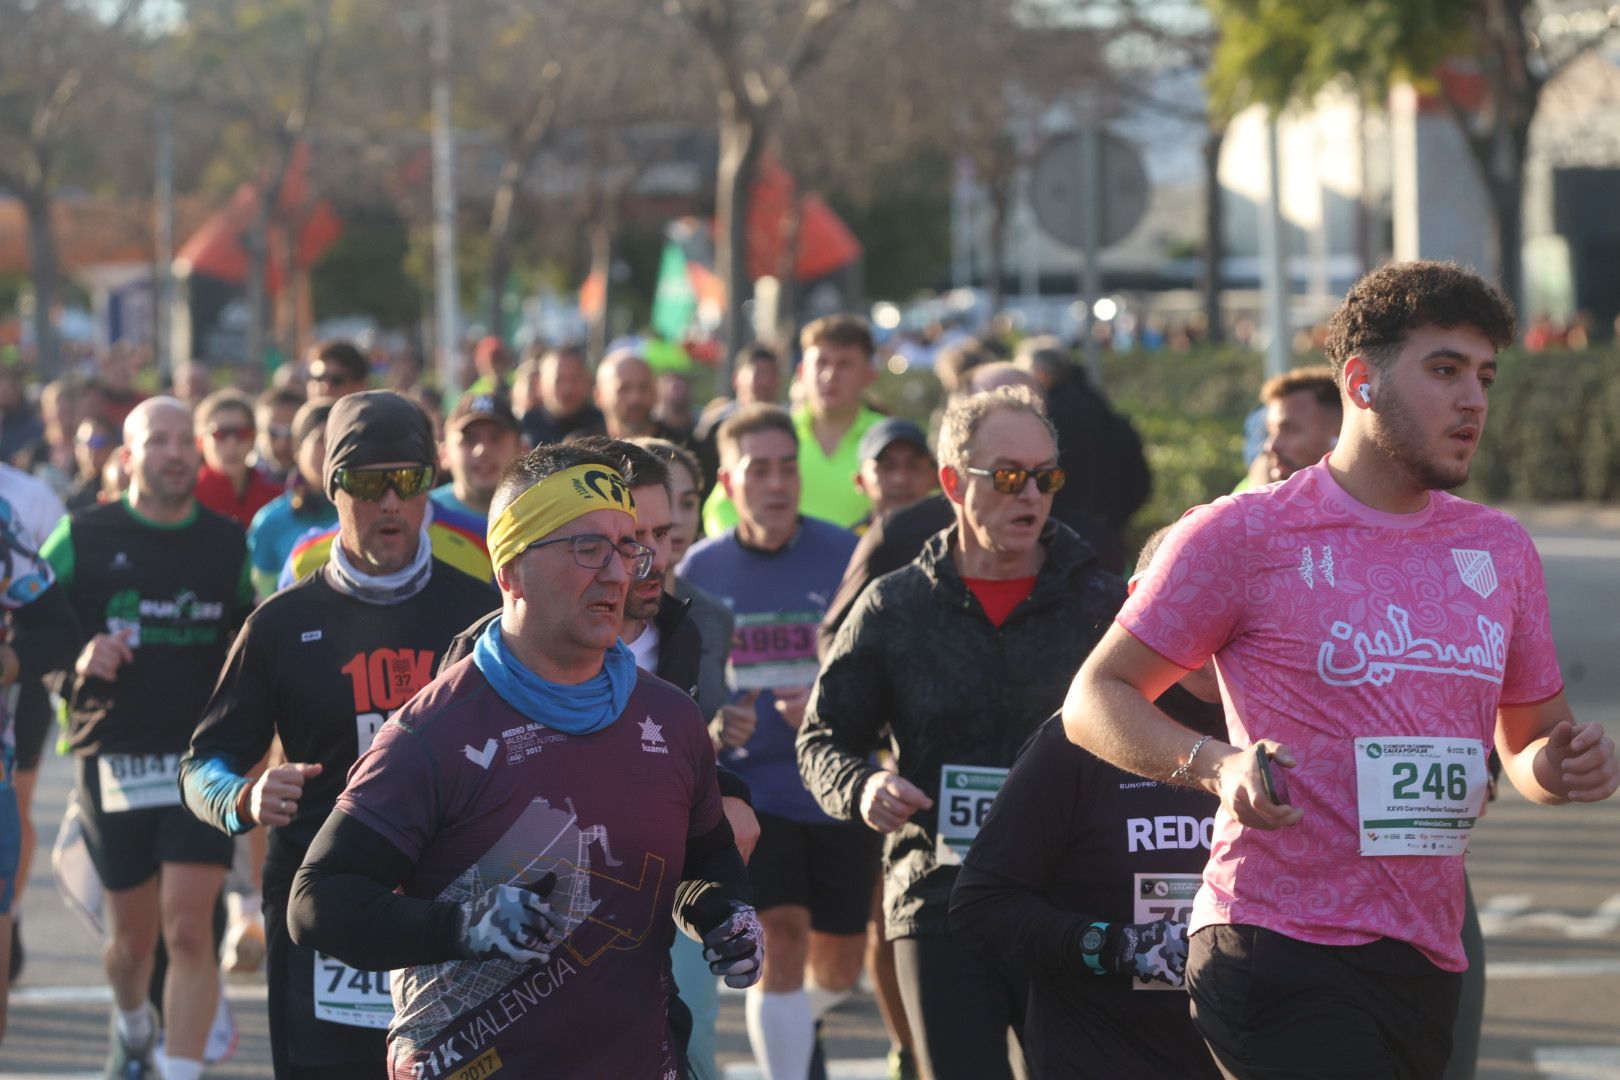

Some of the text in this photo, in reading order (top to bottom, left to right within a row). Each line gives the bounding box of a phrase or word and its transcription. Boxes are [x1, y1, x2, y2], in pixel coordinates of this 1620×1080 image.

[341, 648, 434, 713] 10K
[526, 746, 542, 756] 2017
[1392, 762, 1467, 801] 246
[460, 957, 577, 1050] VALÈNCIA
[460, 1055, 495, 1080] 2017
